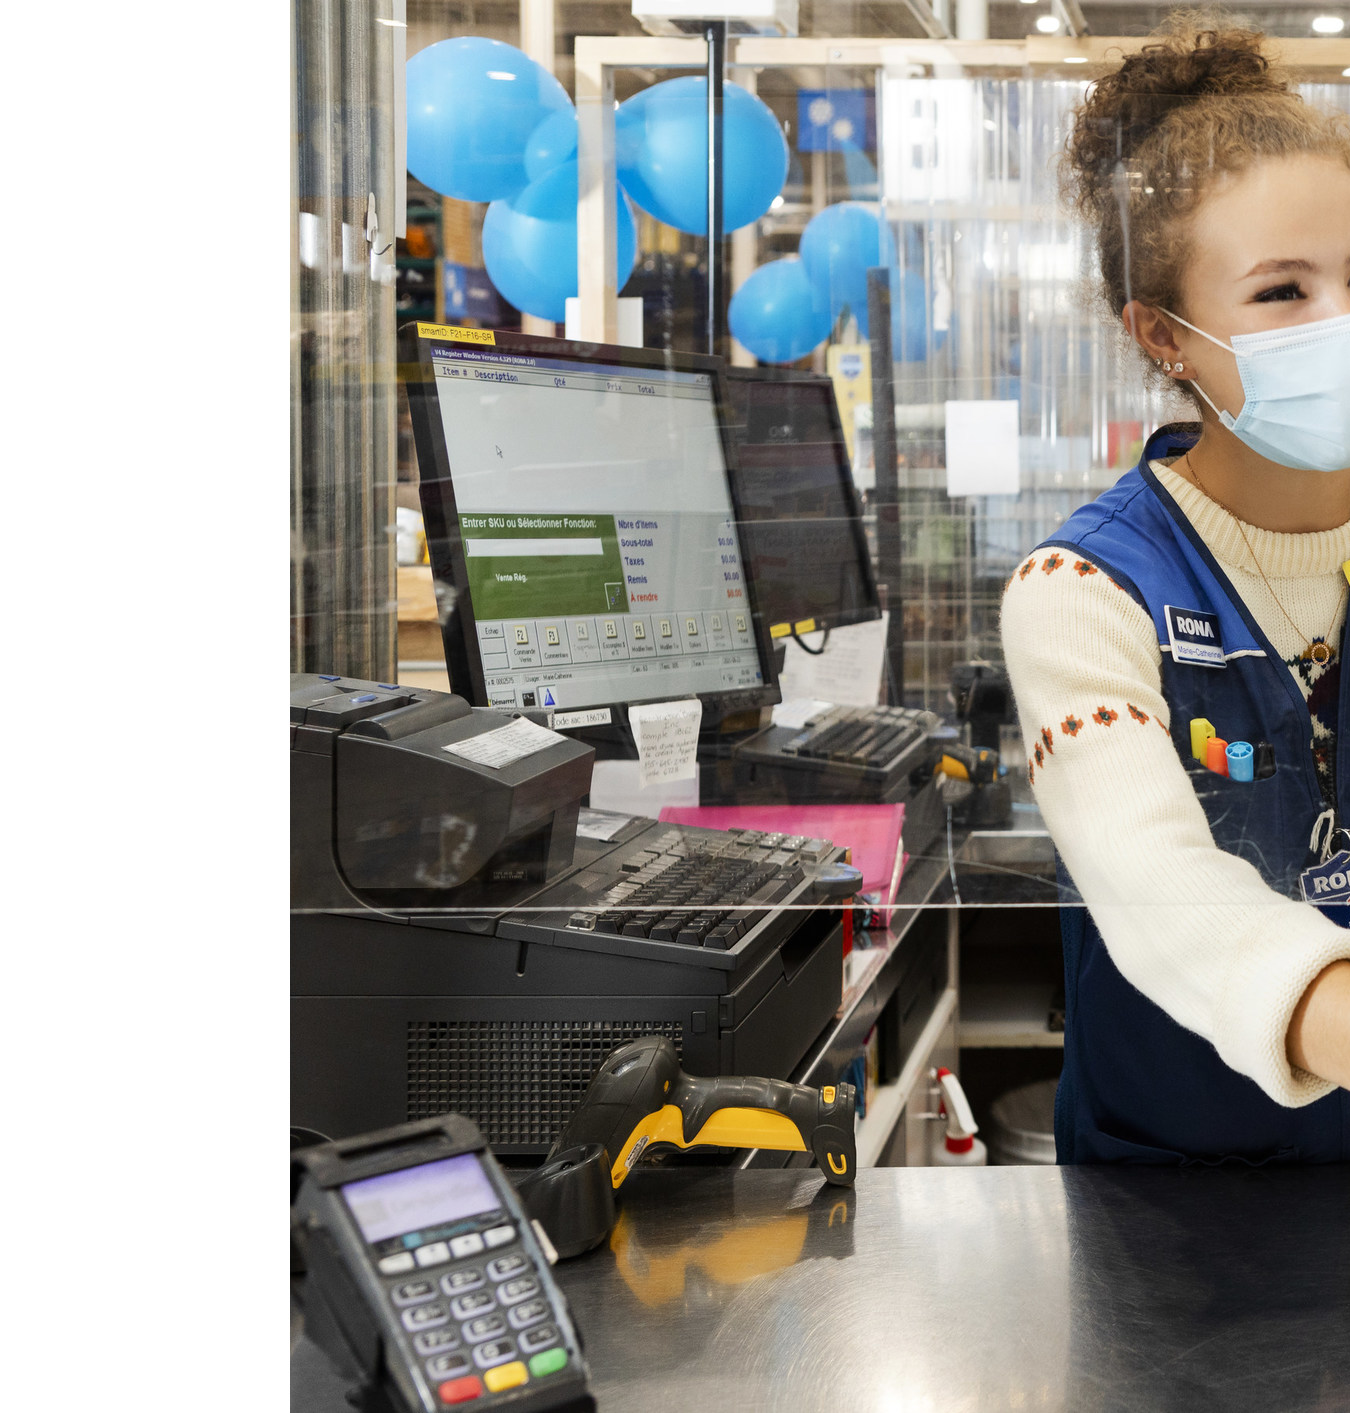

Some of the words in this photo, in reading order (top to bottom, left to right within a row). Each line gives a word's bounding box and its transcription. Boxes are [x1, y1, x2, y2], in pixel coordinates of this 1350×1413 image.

[420, 327, 449, 338] smartID:
[450, 329, 493, 341] F21-F16-SR
[442, 350, 462, 358] Register
[463, 351, 481, 360] Window
[481, 353, 498, 361] Version
[442, 366, 459, 377] Item
[463, 368, 468, 376] #
[474, 369, 519, 383] Description
[554, 377, 566, 388] Qté
[606, 382, 622, 392] Prix
[637, 384, 655, 394] Total
[462, 517, 487, 528] Entrer
[488, 517, 505, 528] SKU
[506, 519, 517, 528] ou
[518, 516, 563, 529] Sélectionner
[563, 517, 597, 529] Fonction:
[618, 519, 634, 530] Nbre
[635, 519, 658, 529] d'items
[621, 538, 654, 548] Sous-total
[717, 537, 734, 547] $0.00
[624, 556, 645, 566] Taxes
[720, 554, 737, 565] $0.00
[495, 573, 513, 582] Vente
[627, 574, 648, 585] Remis
[723, 572, 740, 582] $0.00
[636, 592, 658, 602] rendre
[726, 588, 743, 599] $0.00
[606, 623, 615, 635] F5
[661, 622, 670, 633] F7
[1176, 615, 1215, 638] RONA
[516, 629, 525, 641] F2
[548, 630, 556, 642] F3
[513, 648, 536, 656] Commande
[491, 698, 516, 706] Démarrer
[553, 716, 569, 727] ode
